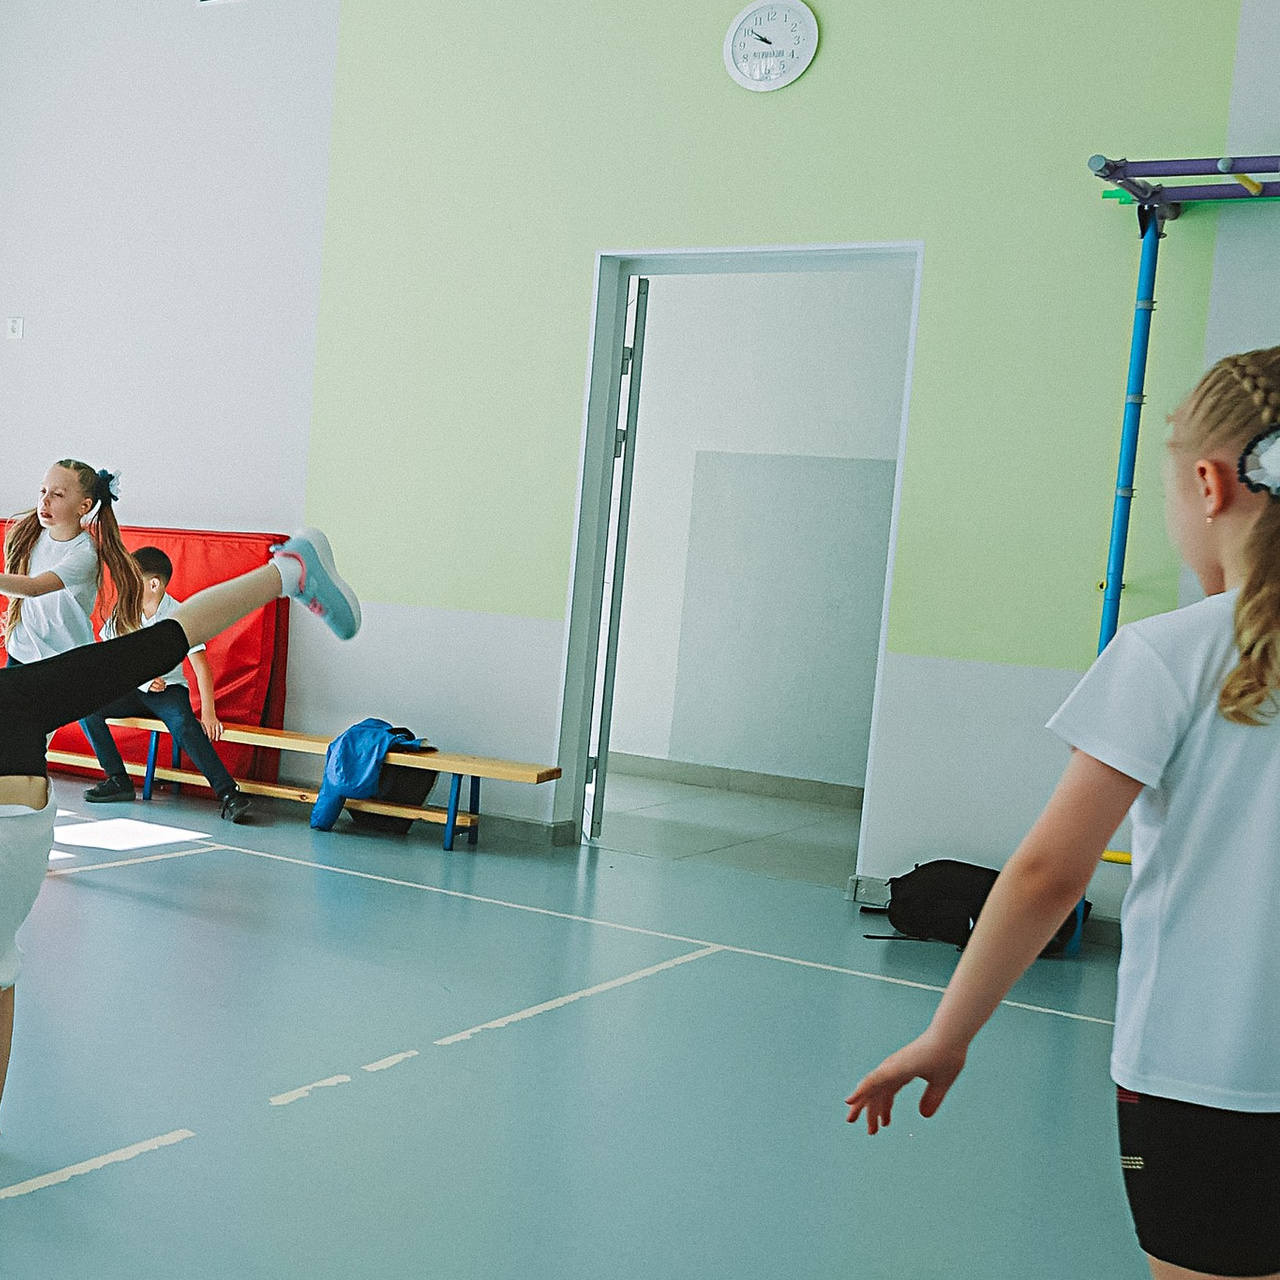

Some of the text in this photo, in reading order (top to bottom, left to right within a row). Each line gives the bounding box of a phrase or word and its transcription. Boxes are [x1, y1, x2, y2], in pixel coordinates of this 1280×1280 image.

[754, 17, 762, 26] 11
[767, 11, 777, 22] 12
[743, 28, 753, 37] 10
[790, 22, 798, 33] 2
[739, 41, 746, 51] 9
[794, 36, 800, 46] 3
[742, 53, 749, 63] 8
[789, 49, 795, 59] 4
[779, 60, 786, 70] 5
